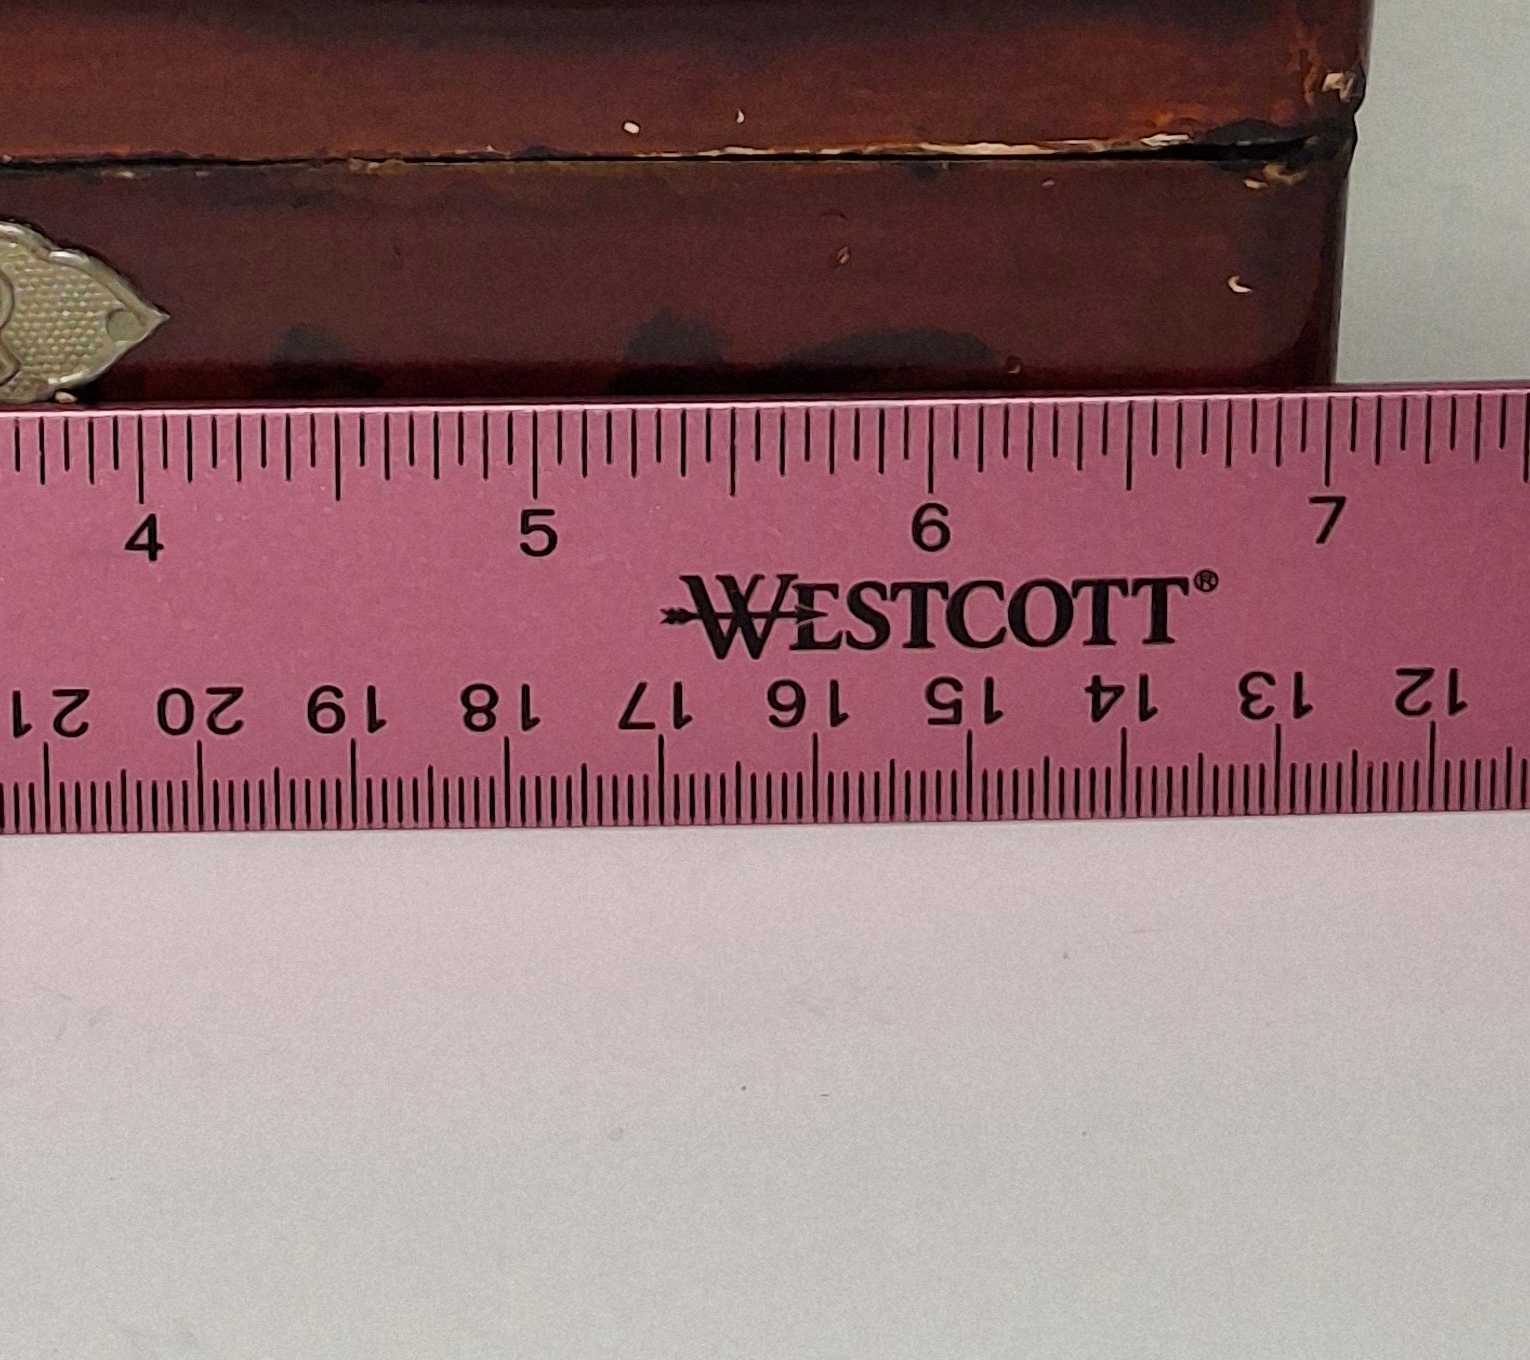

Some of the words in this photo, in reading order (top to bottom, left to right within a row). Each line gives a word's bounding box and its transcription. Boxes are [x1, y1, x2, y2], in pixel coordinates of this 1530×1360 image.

[124, 513, 165, 562] 4
[519, 508, 558, 558] 5
[911, 502, 951, 553] 6
[1308, 495, 1348, 545] 7
[12, 688, 90, 739] 21
[156, 686, 244, 737] 20
[307, 684, 388, 735] 19
[460, 683, 542, 733] 18
[617, 681, 694, 731] 17
[766, 678, 850, 729] 16
[924, 676, 1005, 726] 15
[1083, 673, 1159, 724] 14
[1238, 670, 1314, 721] 13
[1394, 666, 1469, 718] 12
